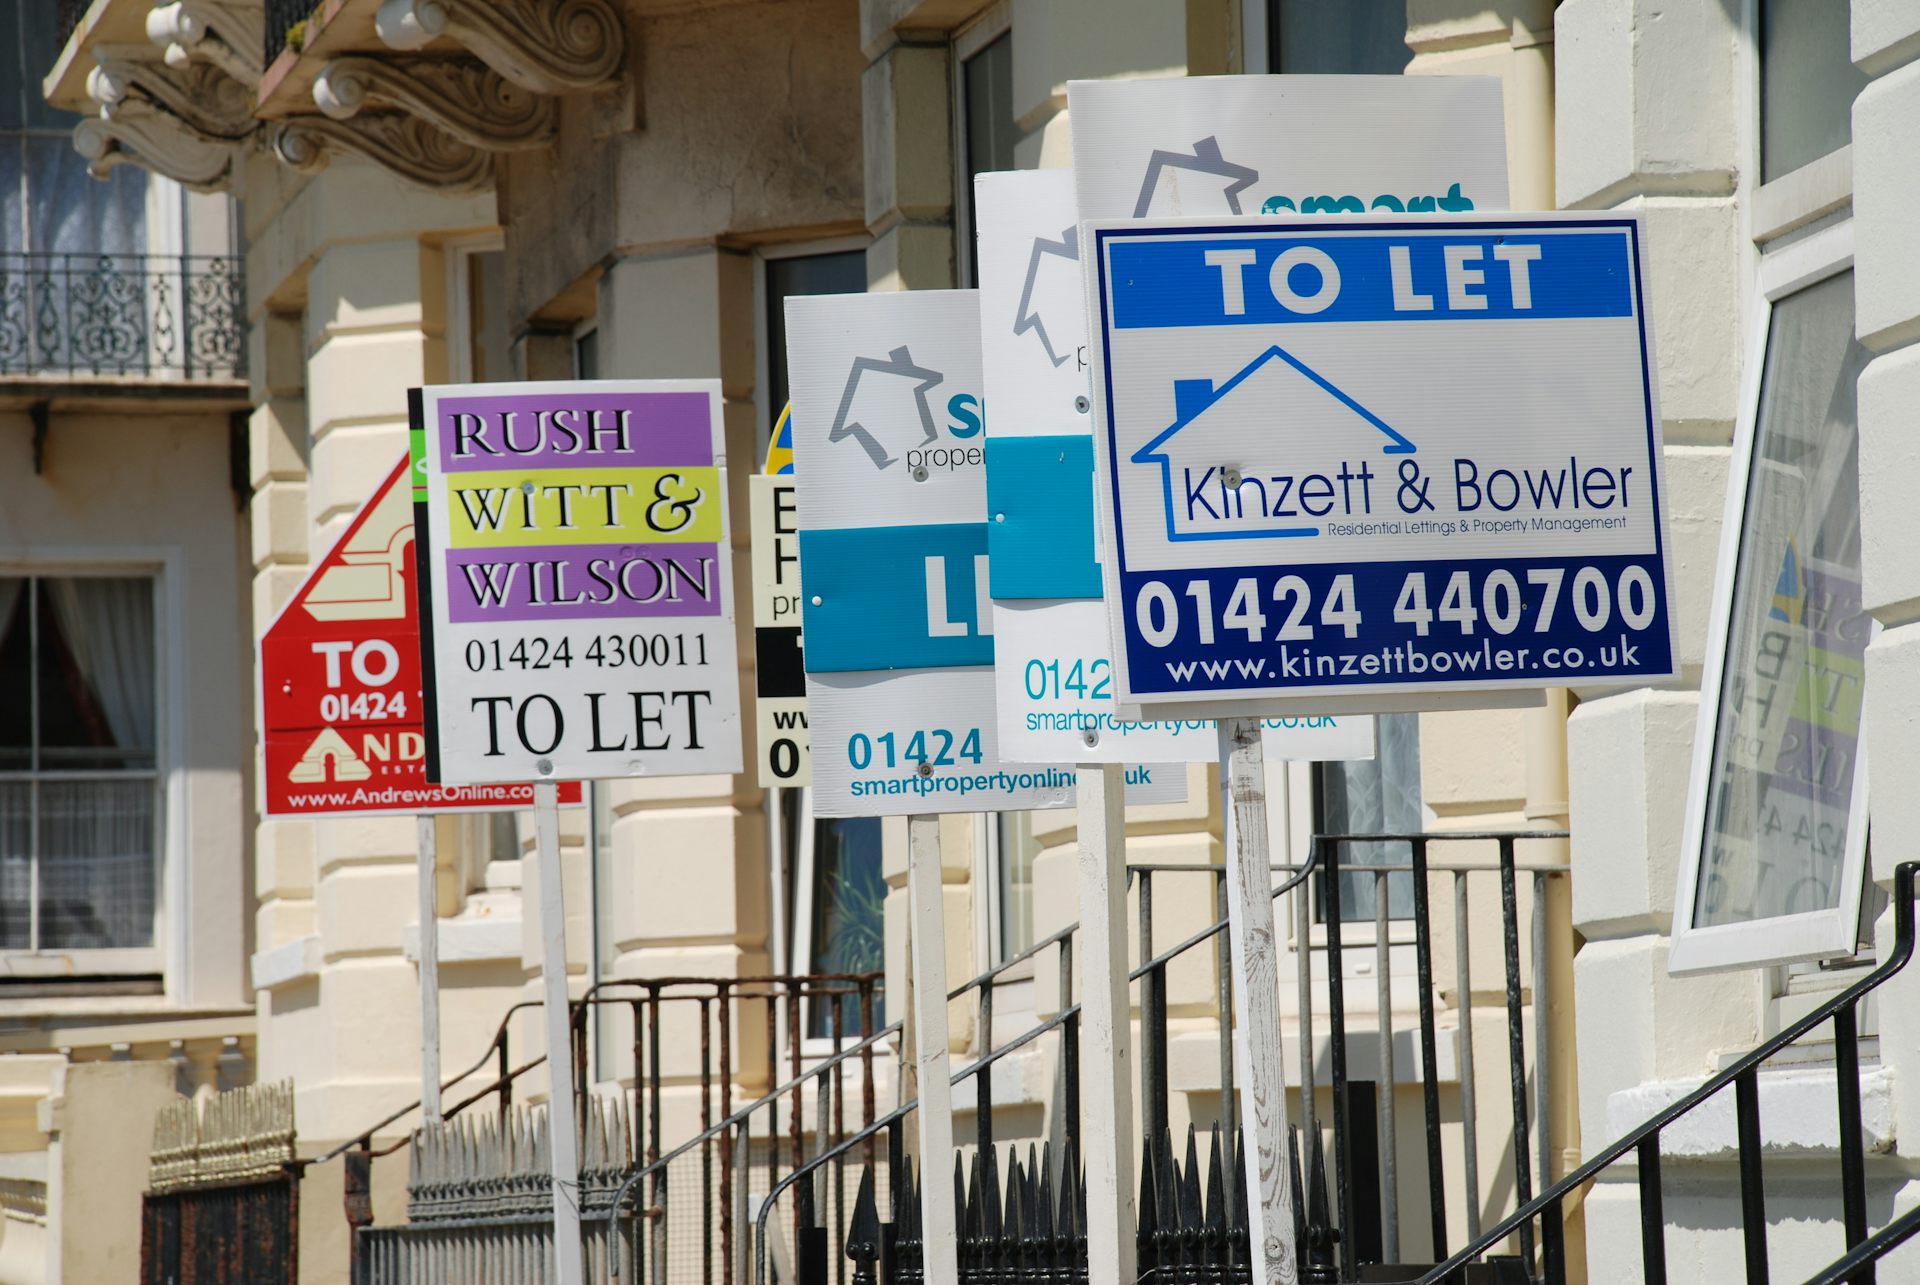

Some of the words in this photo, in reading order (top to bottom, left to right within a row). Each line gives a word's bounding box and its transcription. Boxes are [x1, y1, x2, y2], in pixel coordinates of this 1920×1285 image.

[1205, 246, 1341, 315] TO
[1389, 243, 1541, 312] LET
[449, 409, 634, 459] RUSH
[453, 483, 633, 534] WITT
[645, 474, 705, 535] &
[1185, 460, 1374, 521] Kinzett
[1396, 458, 1435, 514] &
[1455, 456, 1632, 512] Bowler
[1328, 521, 1401, 537] Residential
[1404, 520, 1456, 536] Lettings
[1460, 520, 1470, 533] &
[1473, 518, 1528, 535] Property
[1532, 516, 1627, 533] Management
[457, 556, 714, 609] WILSON
[1136, 572, 1362, 648] 01424
[1393, 564, 1656, 637] 440700
[311, 639, 400, 688] TO
[466, 637, 573, 672] 01424
[585, 633, 709, 668] 430011
[1165, 635, 1640, 684] www.kinzettbowler.co.uk
[1025, 658, 1111, 700] 0142
[320, 691, 407, 722] 01424
[472, 693, 564, 757] TO
[584, 690, 711, 753] LET
[848, 728, 983, 770] 01424
